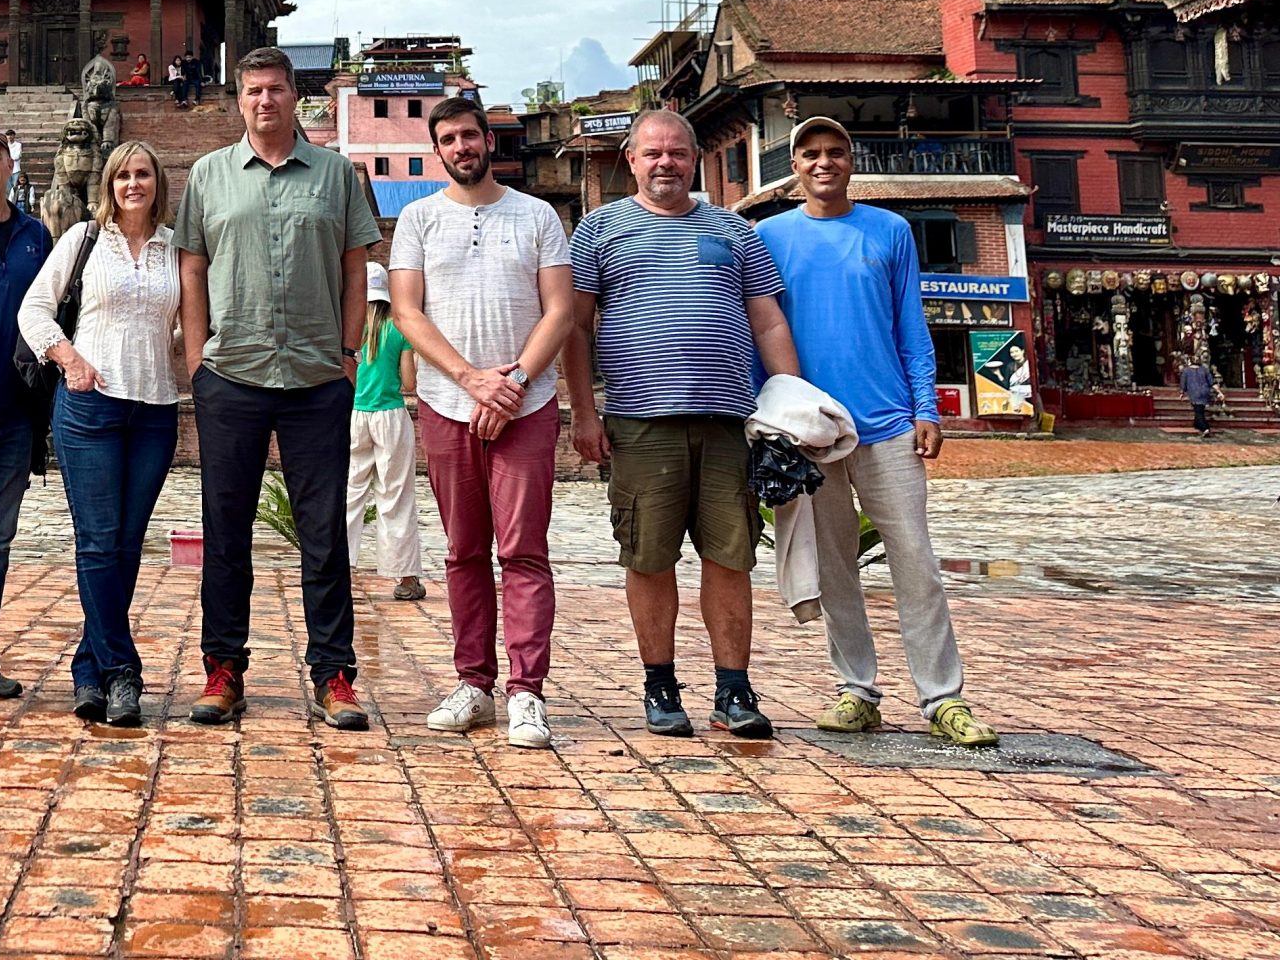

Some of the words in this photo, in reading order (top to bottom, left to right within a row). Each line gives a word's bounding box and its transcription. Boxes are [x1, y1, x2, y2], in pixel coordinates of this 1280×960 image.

[604, 116, 632, 127] STATION
[1047, 222, 1109, 235] Masterpiece
[1113, 223, 1167, 235] Handicraft
[920, 281, 1010, 295] ESTAURANT
